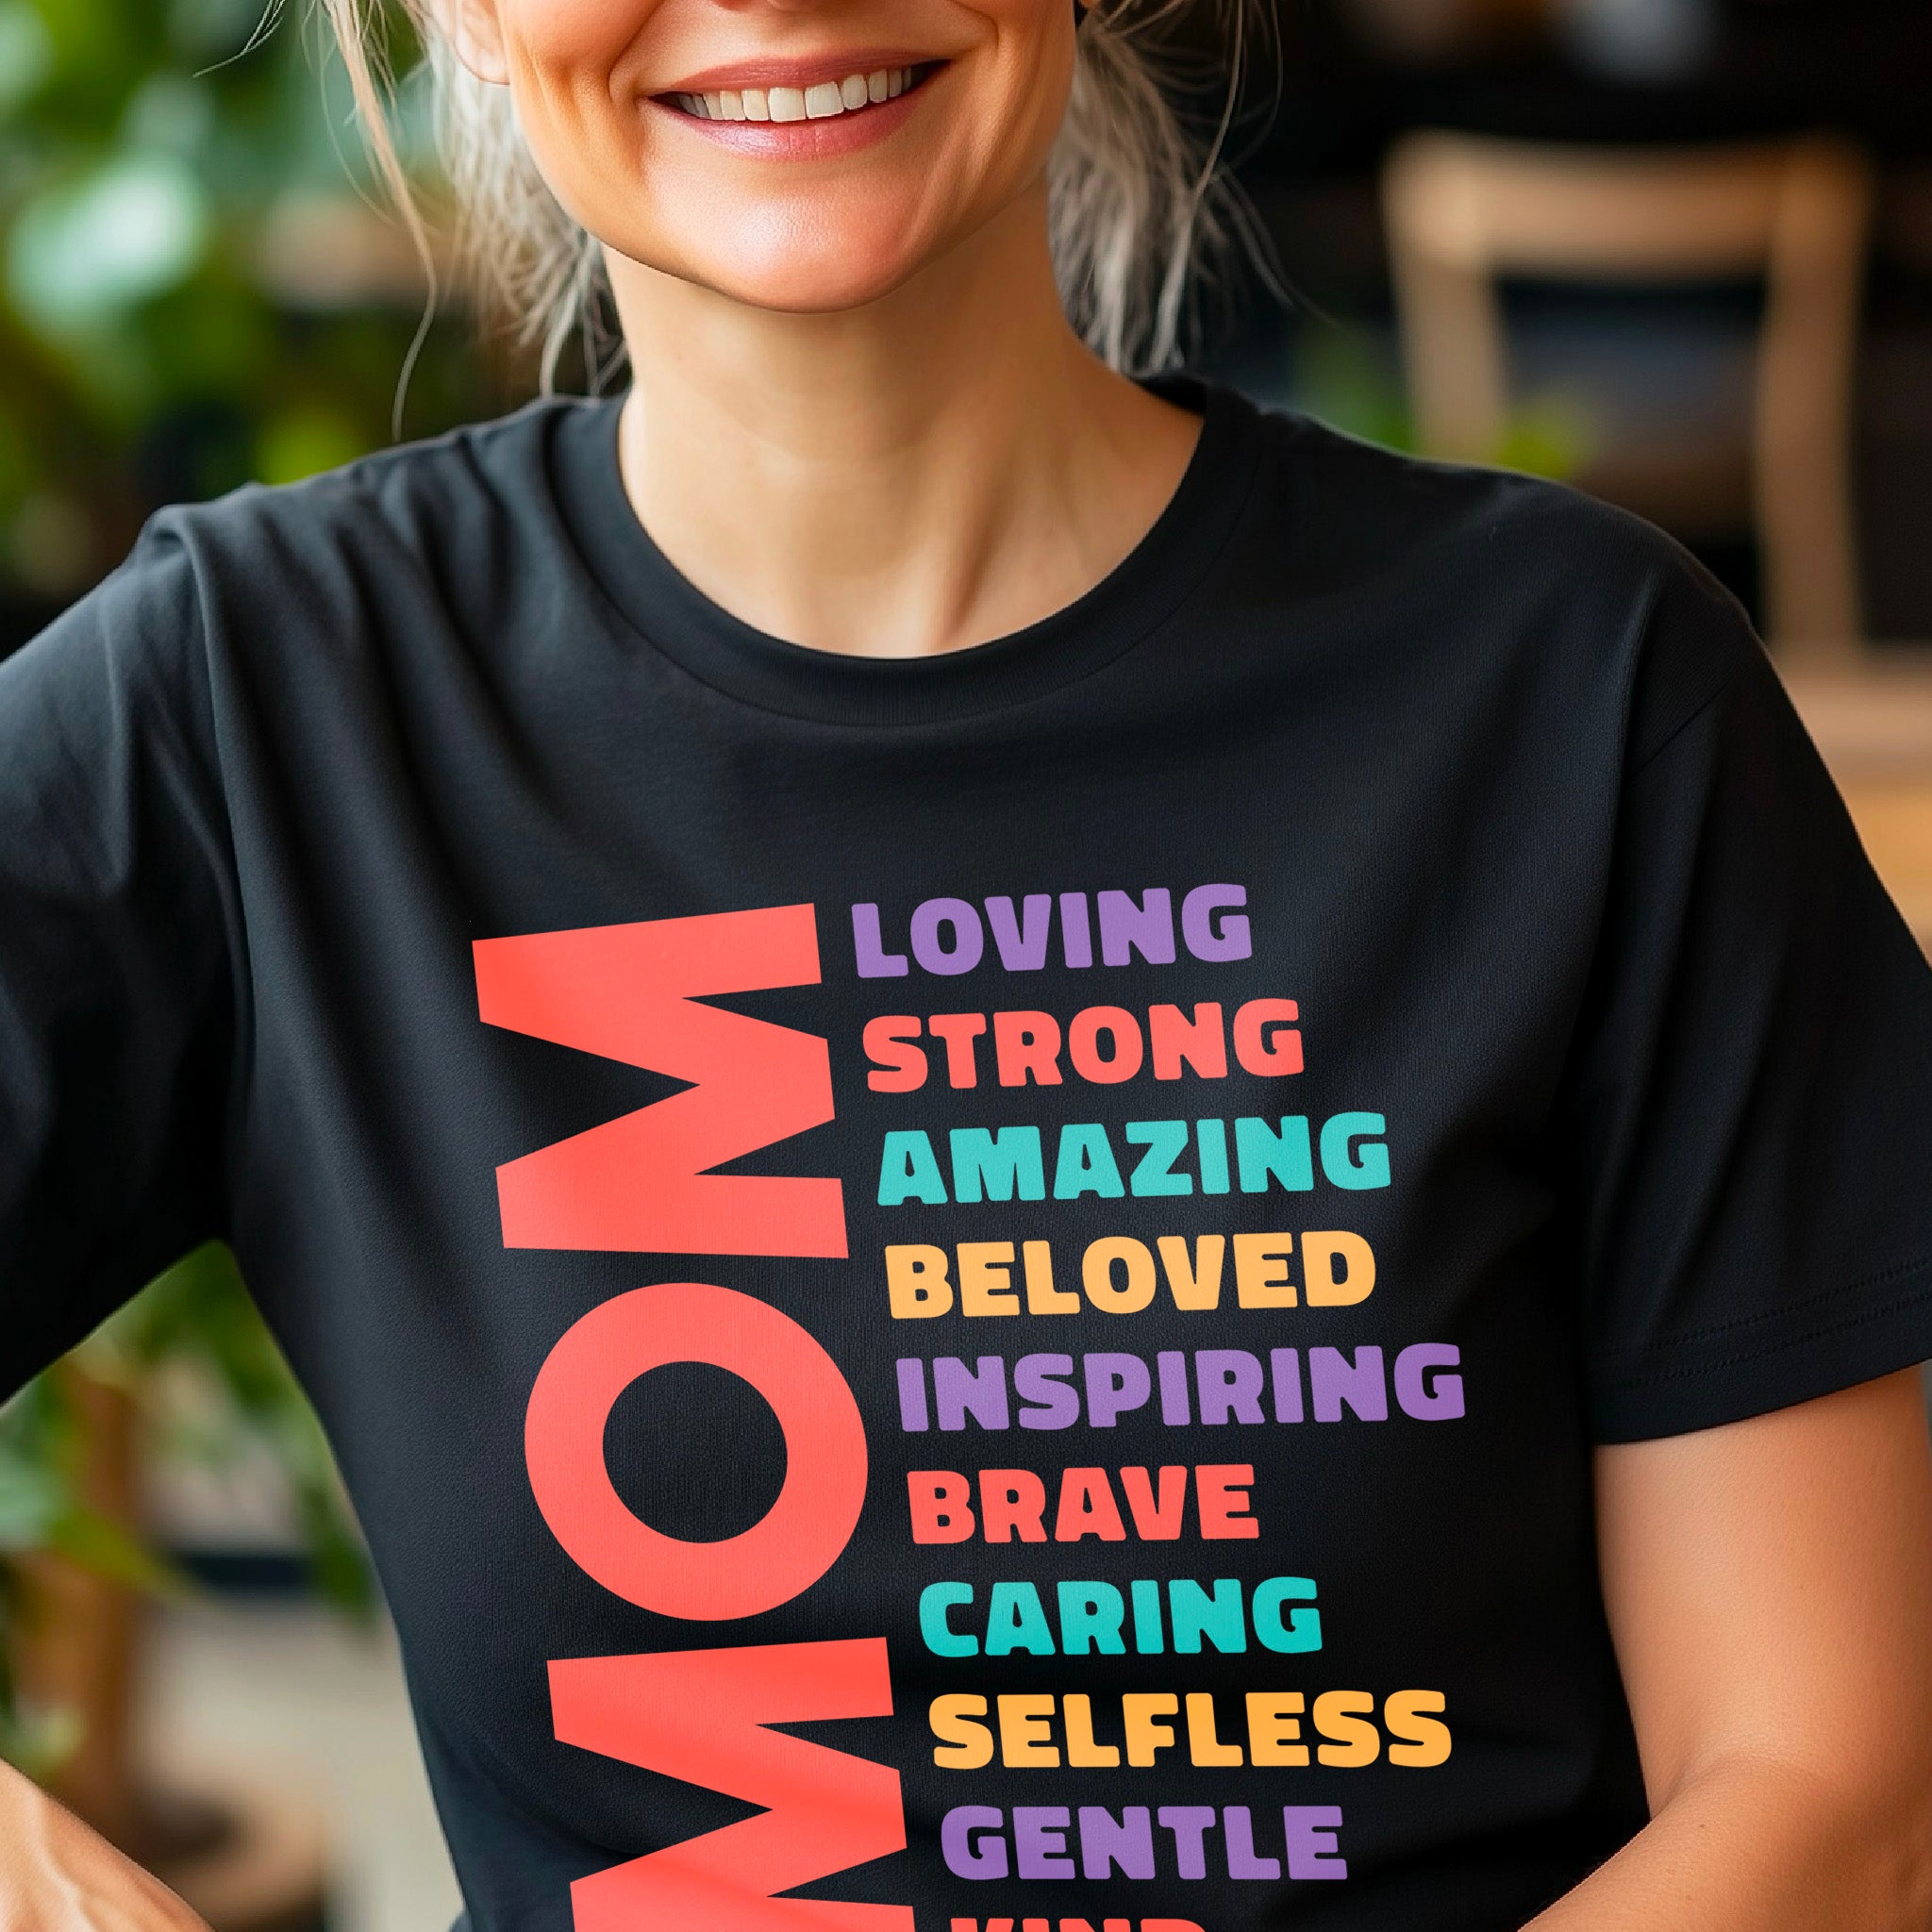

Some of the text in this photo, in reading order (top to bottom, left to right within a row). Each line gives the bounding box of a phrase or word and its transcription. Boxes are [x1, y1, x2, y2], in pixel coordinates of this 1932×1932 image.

[853, 884, 1253, 979] LOVING
[862, 997, 1305, 1093] STRONG
[876, 1111, 1391, 1207] AMAZING
[884, 1230, 1376, 1320] BELOVED
[473, 903, 915, 1932] MOM
[895, 1342, 1466, 1433] INSPIRING
[907, 1463, 1260, 1545] BRAVE
[919, 1576, 1323, 1657] CARING
[928, 1690, 1453, 1770] SELFLESS
[941, 1806, 1347, 1880] GENTLE
